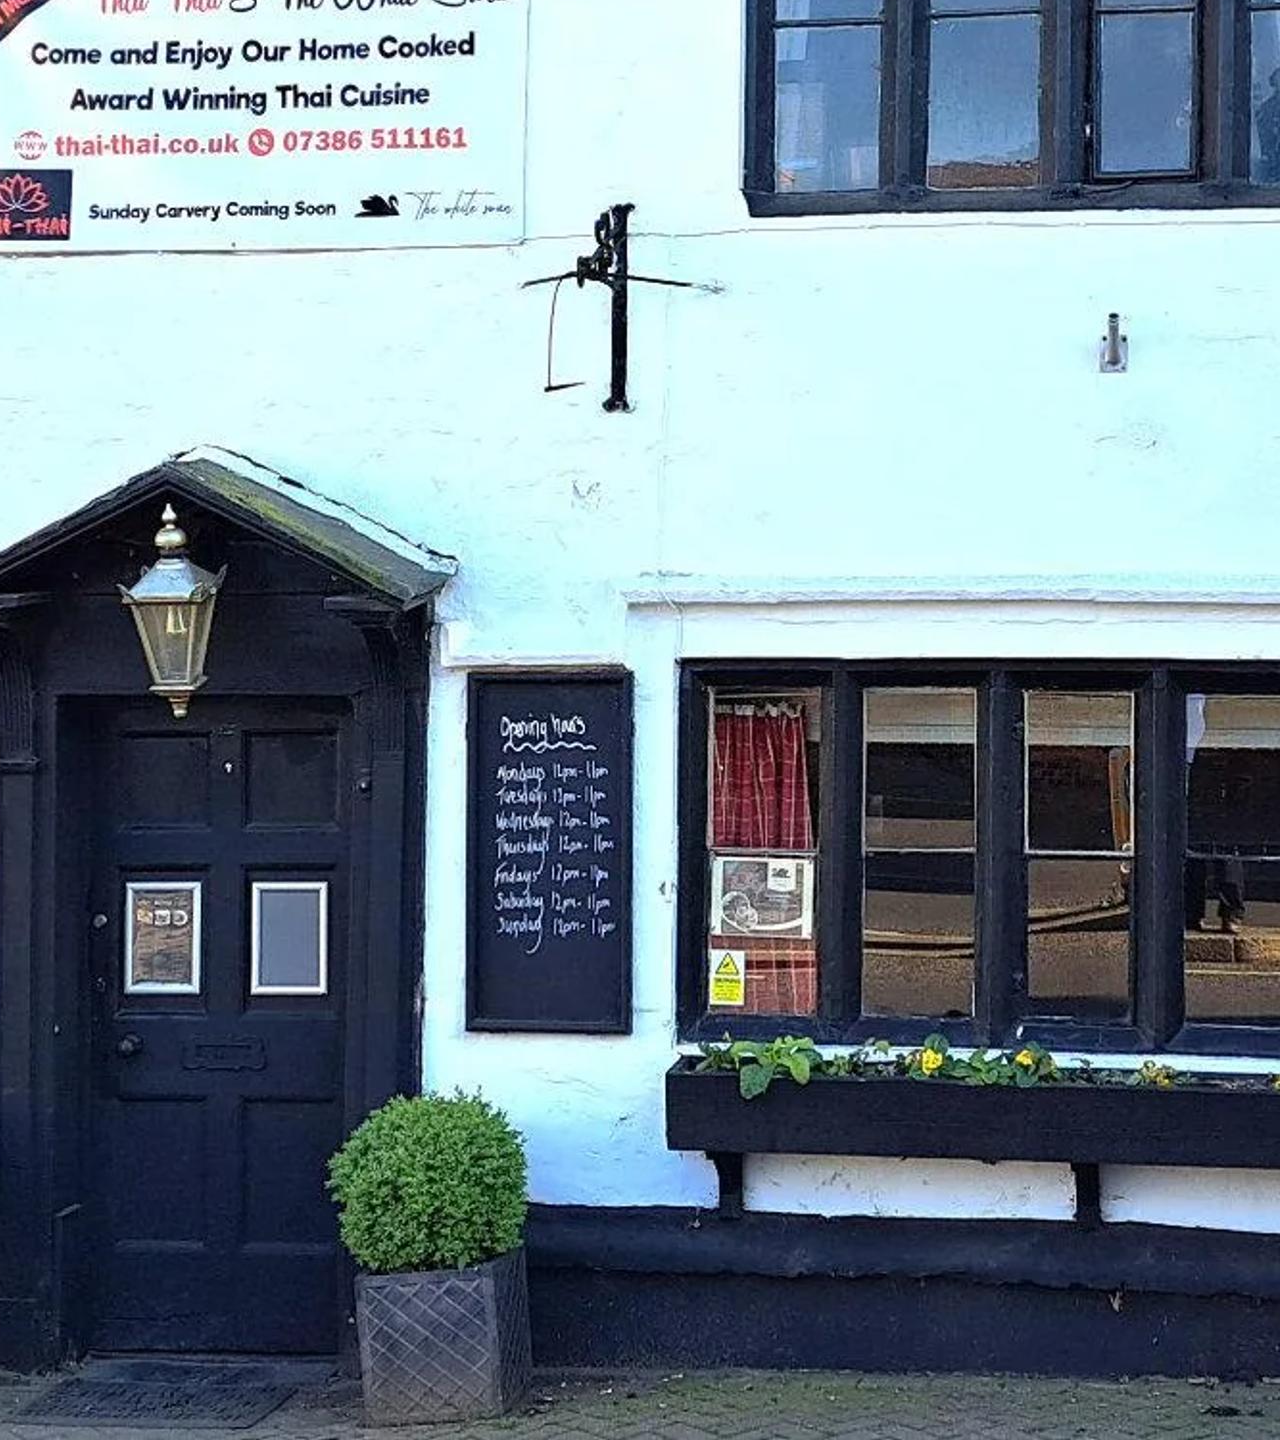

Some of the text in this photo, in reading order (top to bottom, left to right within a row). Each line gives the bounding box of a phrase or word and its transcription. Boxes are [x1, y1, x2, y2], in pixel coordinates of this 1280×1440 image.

[30, 30, 475, 70] Come and Enjoy Our Home Cooked
[70, 81, 430, 116] Award Winning Thai Cuisine
[54, 132, 239, 157] thai-thai.co.uk
[282, 129, 363, 153] 07386
[370, 126, 467, 150] 511161
[88, 200, 336, 224] Sunday Carvery Coming Soon
[404, 188, 513, 220] The white swan
